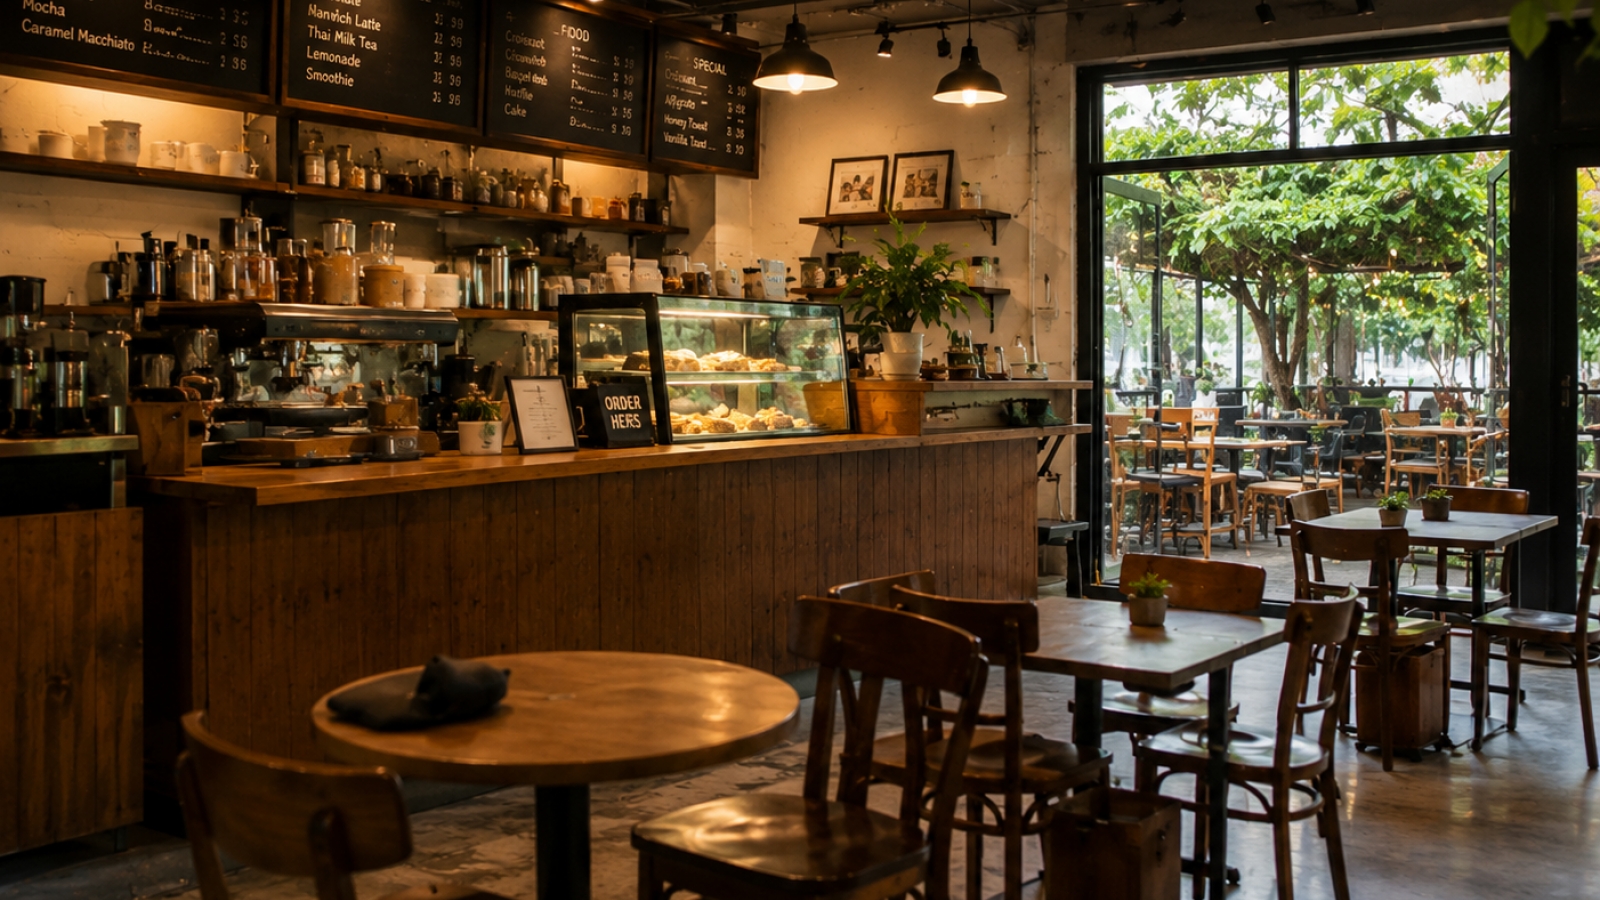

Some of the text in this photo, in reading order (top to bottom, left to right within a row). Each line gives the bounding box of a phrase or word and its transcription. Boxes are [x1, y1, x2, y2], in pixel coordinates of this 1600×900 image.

[22, 0, 66, 17] Mocha
[355, 14, 382, 32] Latte
[21, 18, 75, 41] Caramel
[77, 28, 136, 52] Macchiato
[307, 24, 378, 51] Thai Milk Tea
[306, 45, 362, 68] Lemonade
[305, 66, 355, 88] Smoothie
[503, 103, 527, 118] Cake
[604, 395, 642, 411] ORDER
